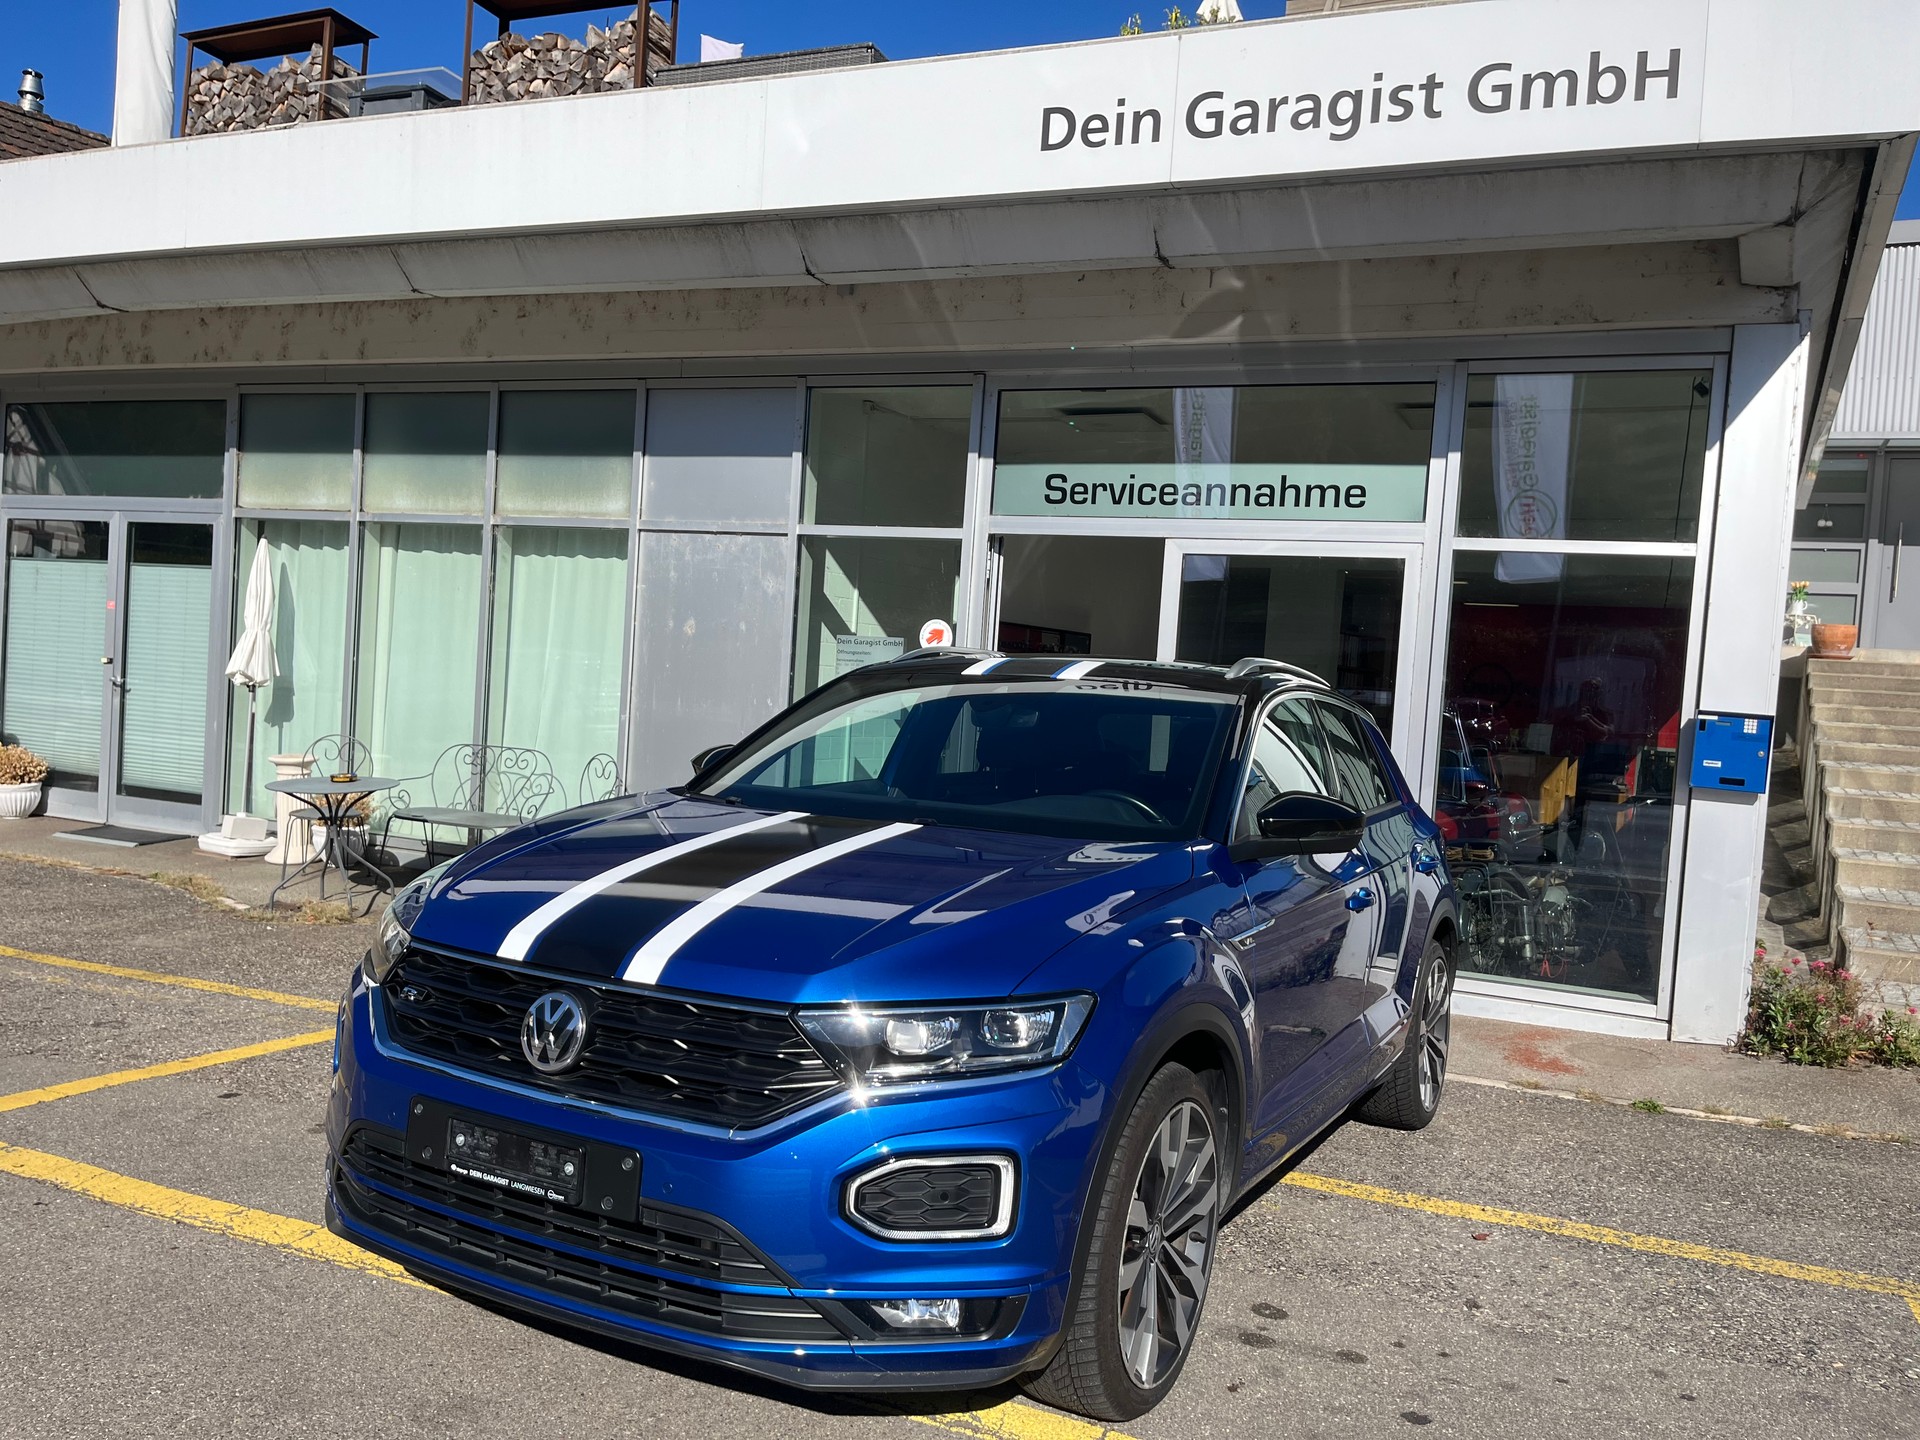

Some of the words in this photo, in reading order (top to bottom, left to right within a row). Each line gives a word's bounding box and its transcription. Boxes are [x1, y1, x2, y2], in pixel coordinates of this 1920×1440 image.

[1040, 97, 1162, 152] Dein
[1185, 70, 1444, 141] Garagist
[1467, 48, 1681, 114] GmbH
[1044, 473, 1367, 509] Serviceannahme
[853, 638, 881, 648] Garagist
[882, 639, 903, 647] GmbH
[469, 1168, 483, 1179] DEIN
[482, 1173, 510, 1187] GARAGIST
[510, 1180, 546, 1197] LANGWIESEN
